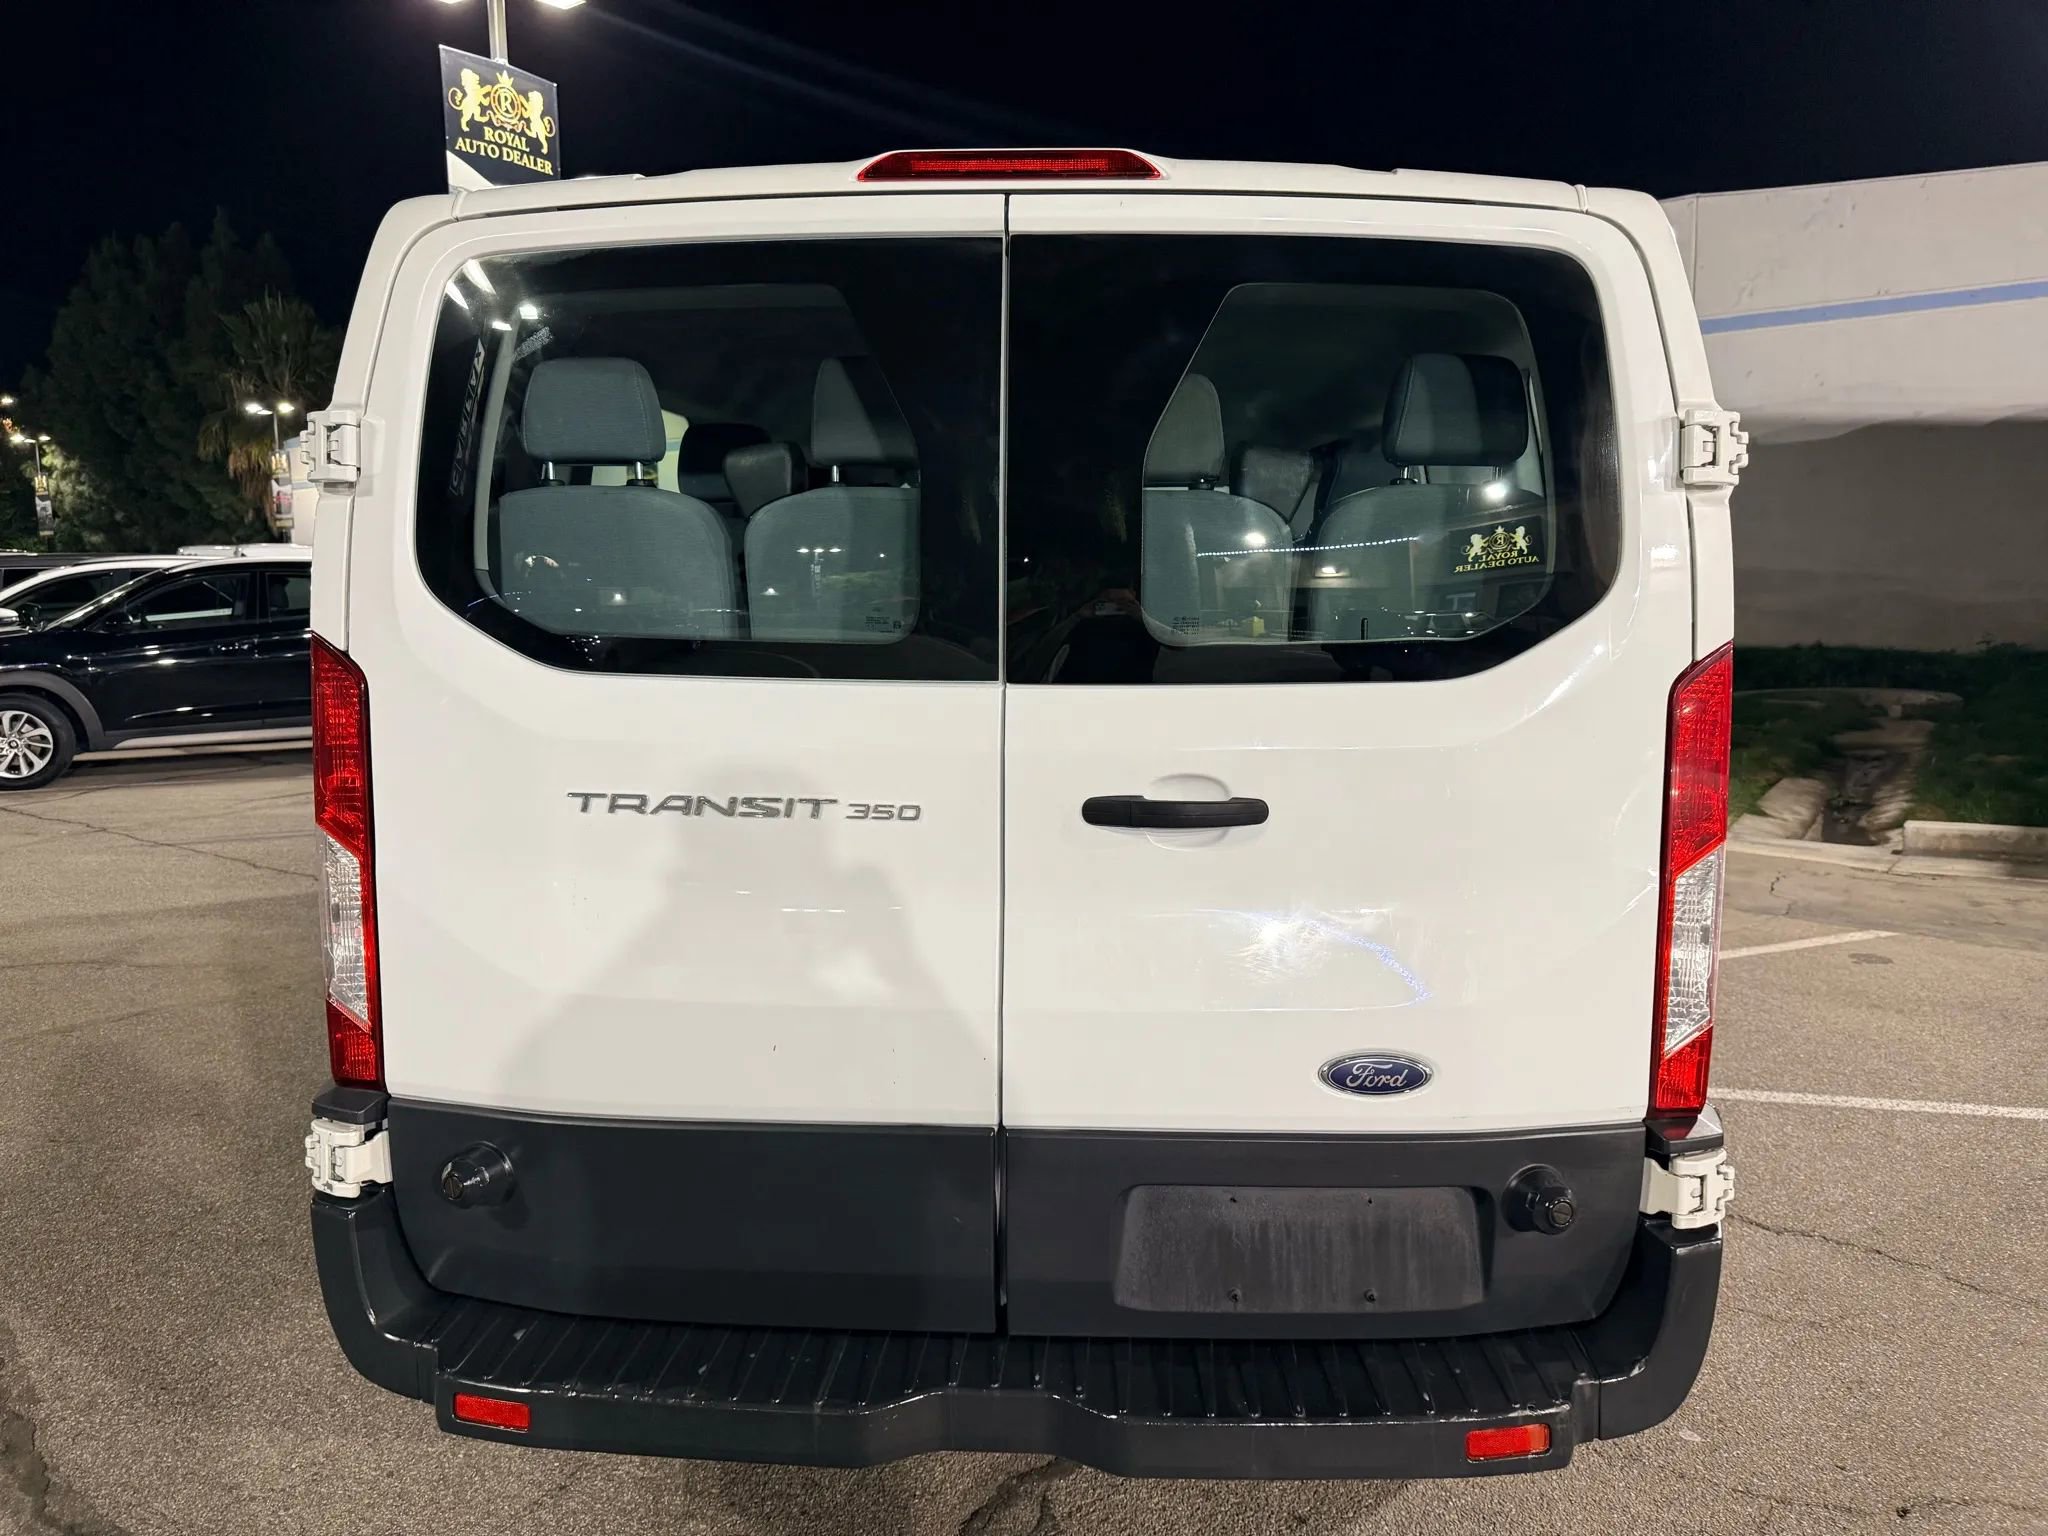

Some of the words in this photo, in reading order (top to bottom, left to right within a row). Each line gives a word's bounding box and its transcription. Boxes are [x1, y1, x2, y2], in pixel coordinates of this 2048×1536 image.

[500, 91, 513, 113] R
[483, 126, 530, 152] ROYAL
[454, 137, 500, 159] AUTO
[502, 147, 553, 176] DEALER
[566, 792, 838, 819] TRANSIT
[846, 803, 921, 820] 350
[1346, 1062, 1408, 1088] Ford
